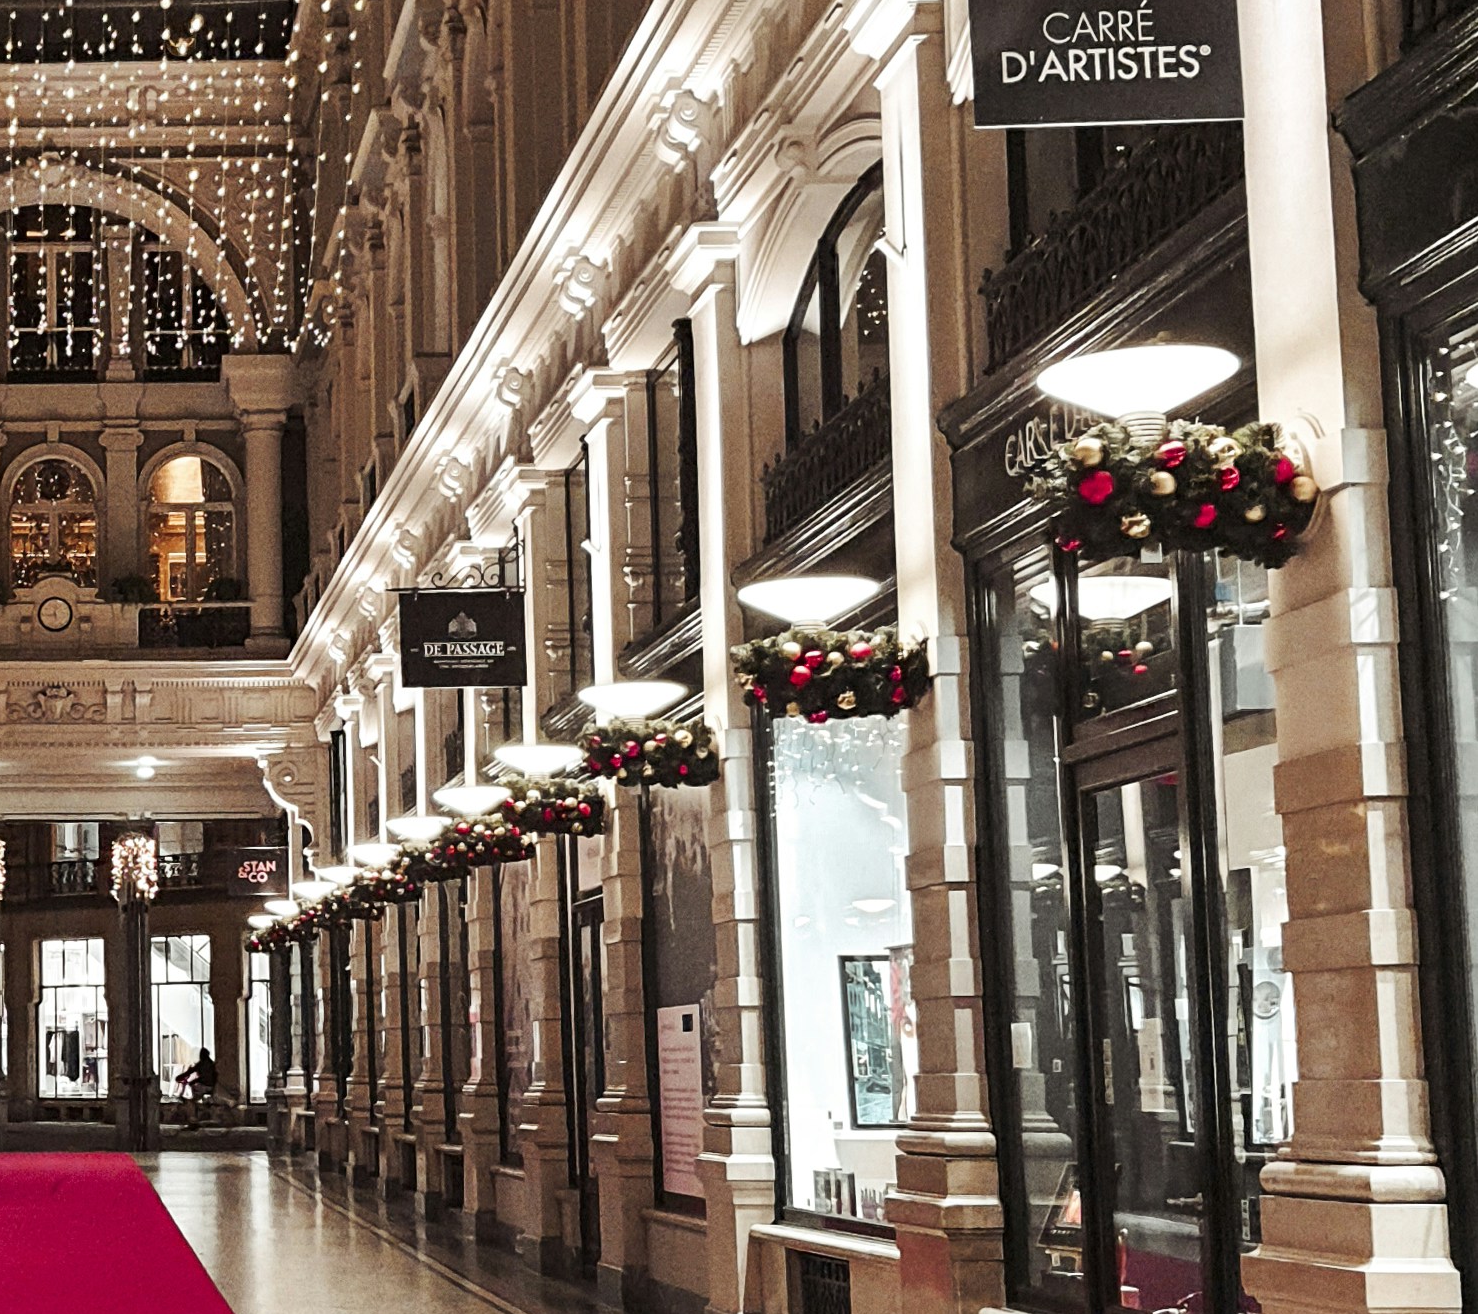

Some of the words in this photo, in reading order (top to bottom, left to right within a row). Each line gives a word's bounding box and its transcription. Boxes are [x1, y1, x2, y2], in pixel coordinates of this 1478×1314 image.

[1042, 0, 1155, 44] CARRÉ
[424, 642, 442, 656] DE
[446, 641, 504, 656] PASSAGE
[243, 860, 276, 872] STAN
[238, 866, 248, 878] &
[248, 871, 268, 883] CO
